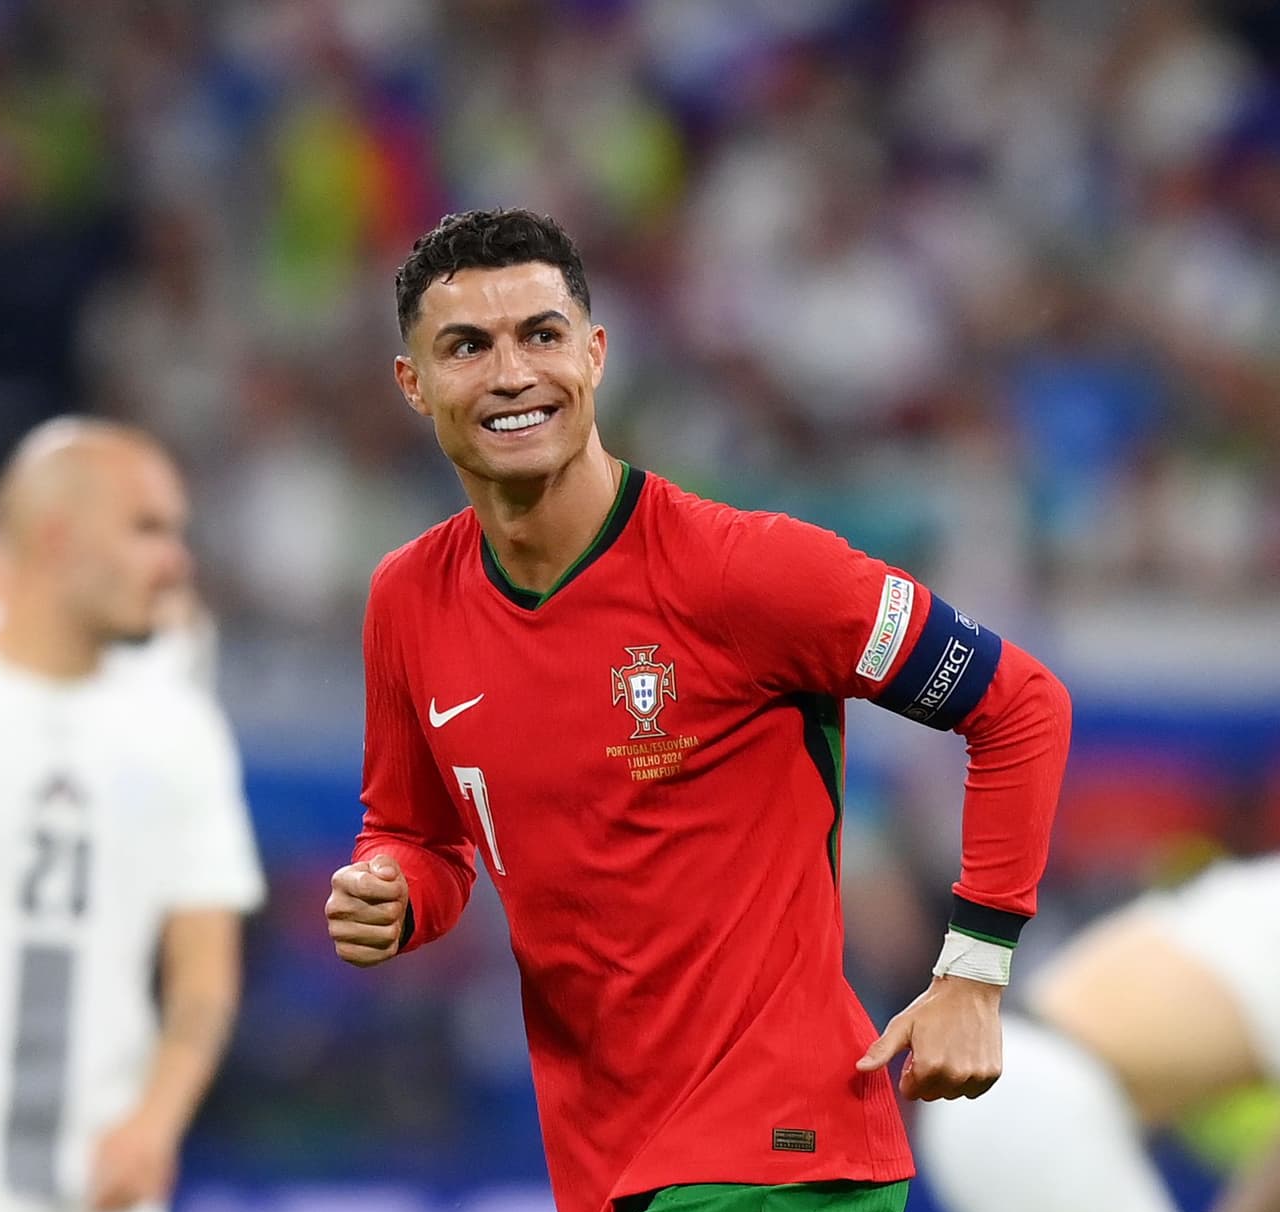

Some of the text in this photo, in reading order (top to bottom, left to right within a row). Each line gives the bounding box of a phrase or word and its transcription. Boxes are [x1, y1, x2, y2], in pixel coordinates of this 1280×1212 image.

[866, 579, 903, 677] FOUNDATION
[920, 639, 969, 708] RESPECT
[630, 764, 682, 781] FRANKFURT
[632, 755, 660, 769] JULHO
[661, 751, 683, 765] 2024
[450, 765, 507, 877] 7
[18, 828, 94, 920] 21
